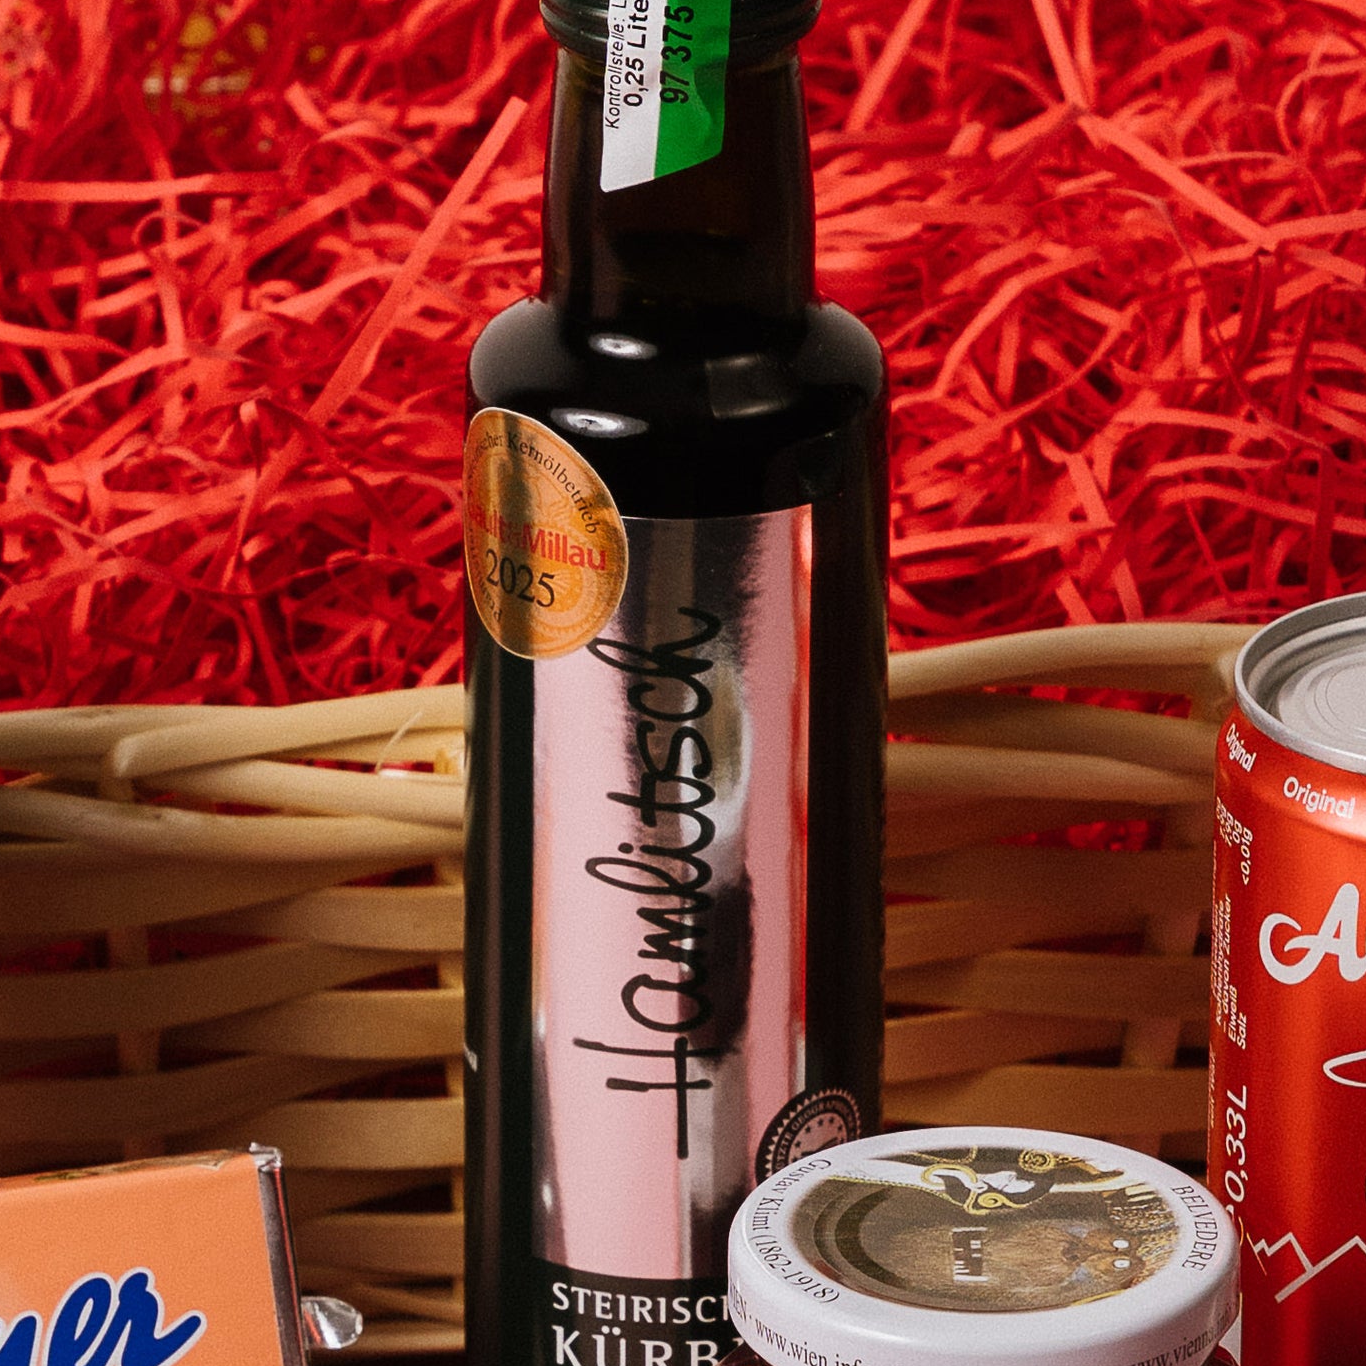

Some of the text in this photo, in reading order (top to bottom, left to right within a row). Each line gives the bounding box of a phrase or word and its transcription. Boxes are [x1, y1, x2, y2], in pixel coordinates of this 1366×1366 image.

[662, 5, 695, 63] 375
[604, 17, 626, 130] Kontrollstelle:
[623, 56, 648, 108] 0,25
[659, 68, 691, 105] 97
[507, 433, 599, 535] Kernölbetrieb
[485, 547, 556, 608] 2025
[1225, 722, 1258, 774] Original
[1283, 776, 1357, 821] Original
[572, 605, 724, 1160] Hamlitsch
[1236, 829, 1254, 1050] Salz <0,01g
[1227, 984, 1239, 1043] Eiweiß
[1225, 1085, 1249, 1203] 0,33L
[771, 1158, 832, 1198] Gustav
[752, 1194, 785, 1232] Klimt
[1171, 1184, 1220, 1272] BELVEDERE
[748, 1231, 842, 1305] (1862-1918)
[552, 1282, 730, 1326] STEIRISC
